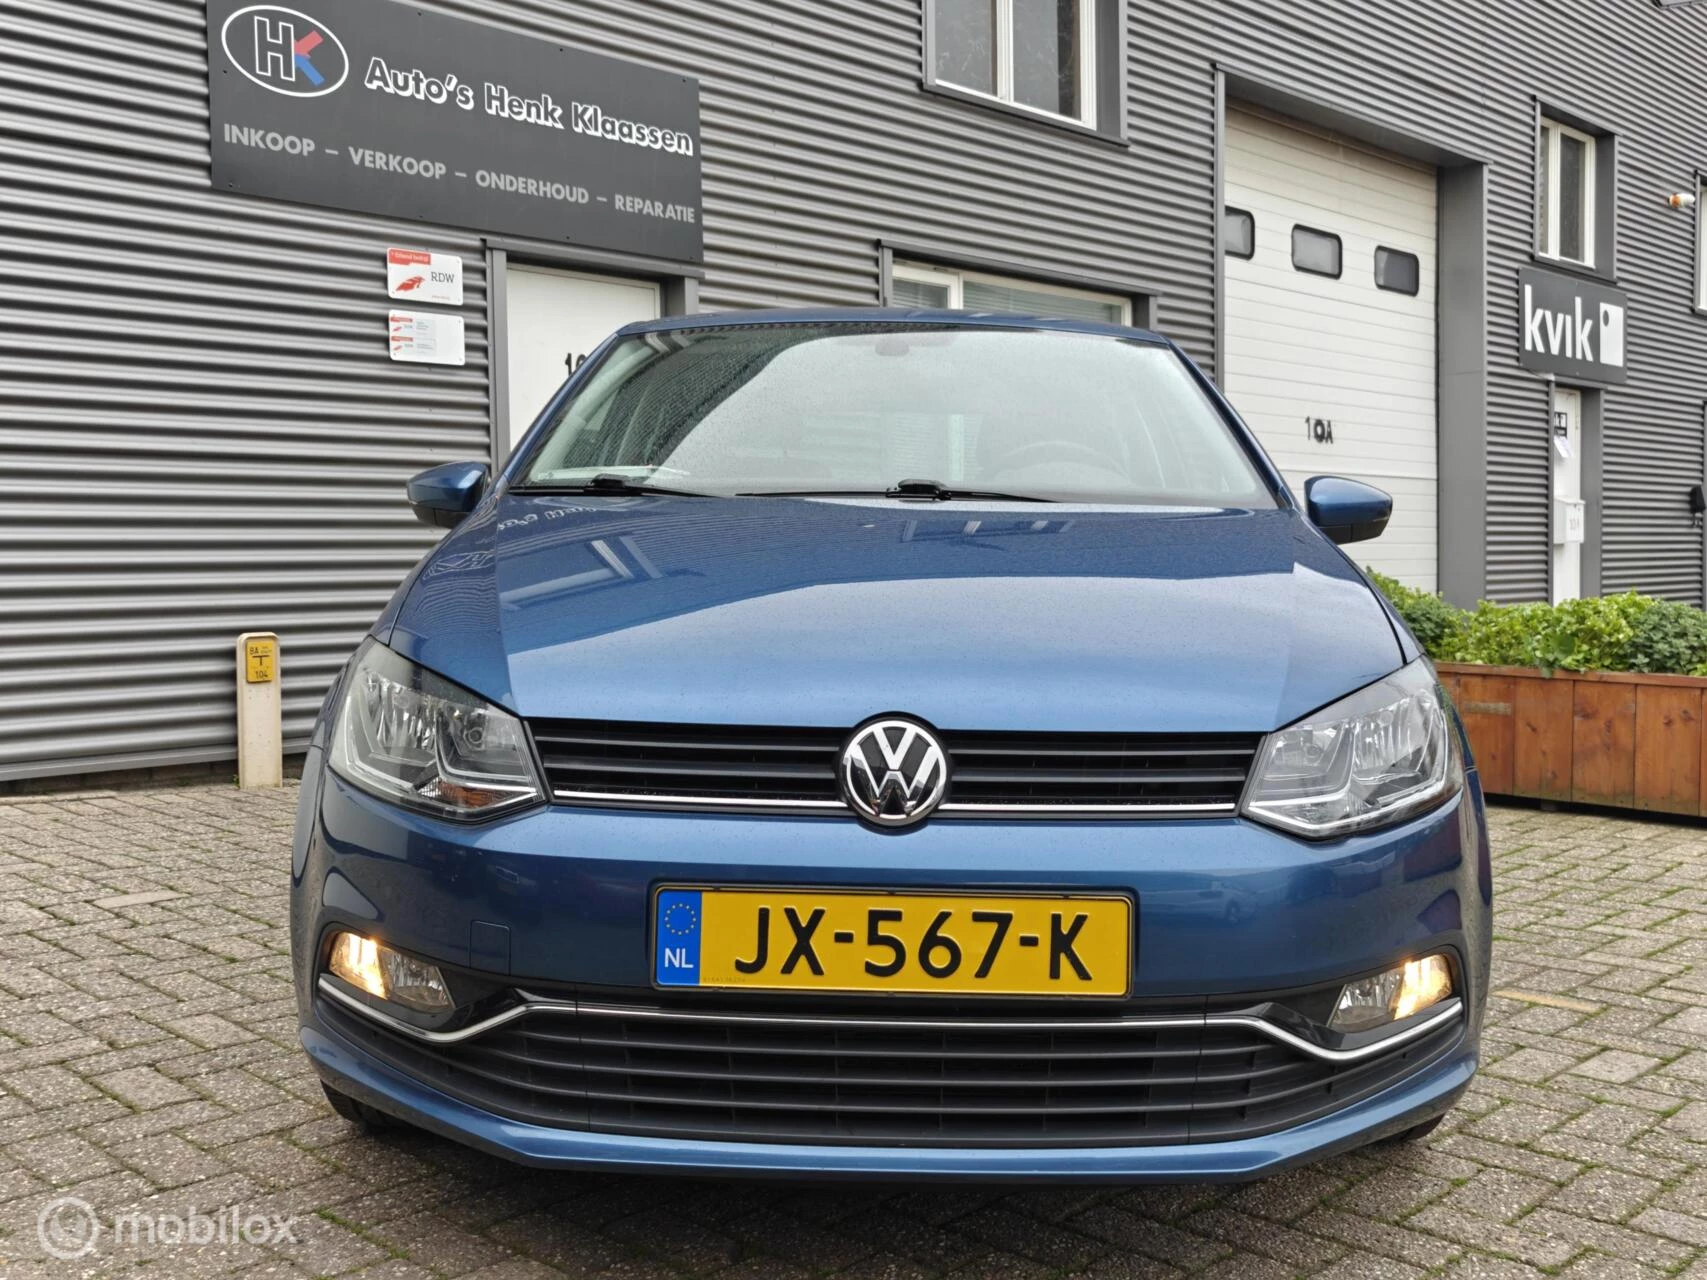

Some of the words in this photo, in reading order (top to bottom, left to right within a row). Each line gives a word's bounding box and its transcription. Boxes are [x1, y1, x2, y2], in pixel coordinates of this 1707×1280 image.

[364, 57, 474, 110] Auto's
[484, 83, 563, 128] Henk
[571, 102, 693, 156] Klaassen
[224, 124, 315, 157] INKOOP
[348, 147, 446, 180] VERKOOP
[475, 170, 589, 204] ONDERHOUD
[615, 194, 695, 223] REPARATIE
[431, 272, 454, 284] RDW
[1524, 284, 1593, 362] kvik
[1305, 416, 1333, 444] 10A
[664, 948, 693, 968] NL
[735, 906, 1093, 981] JX-567-K
